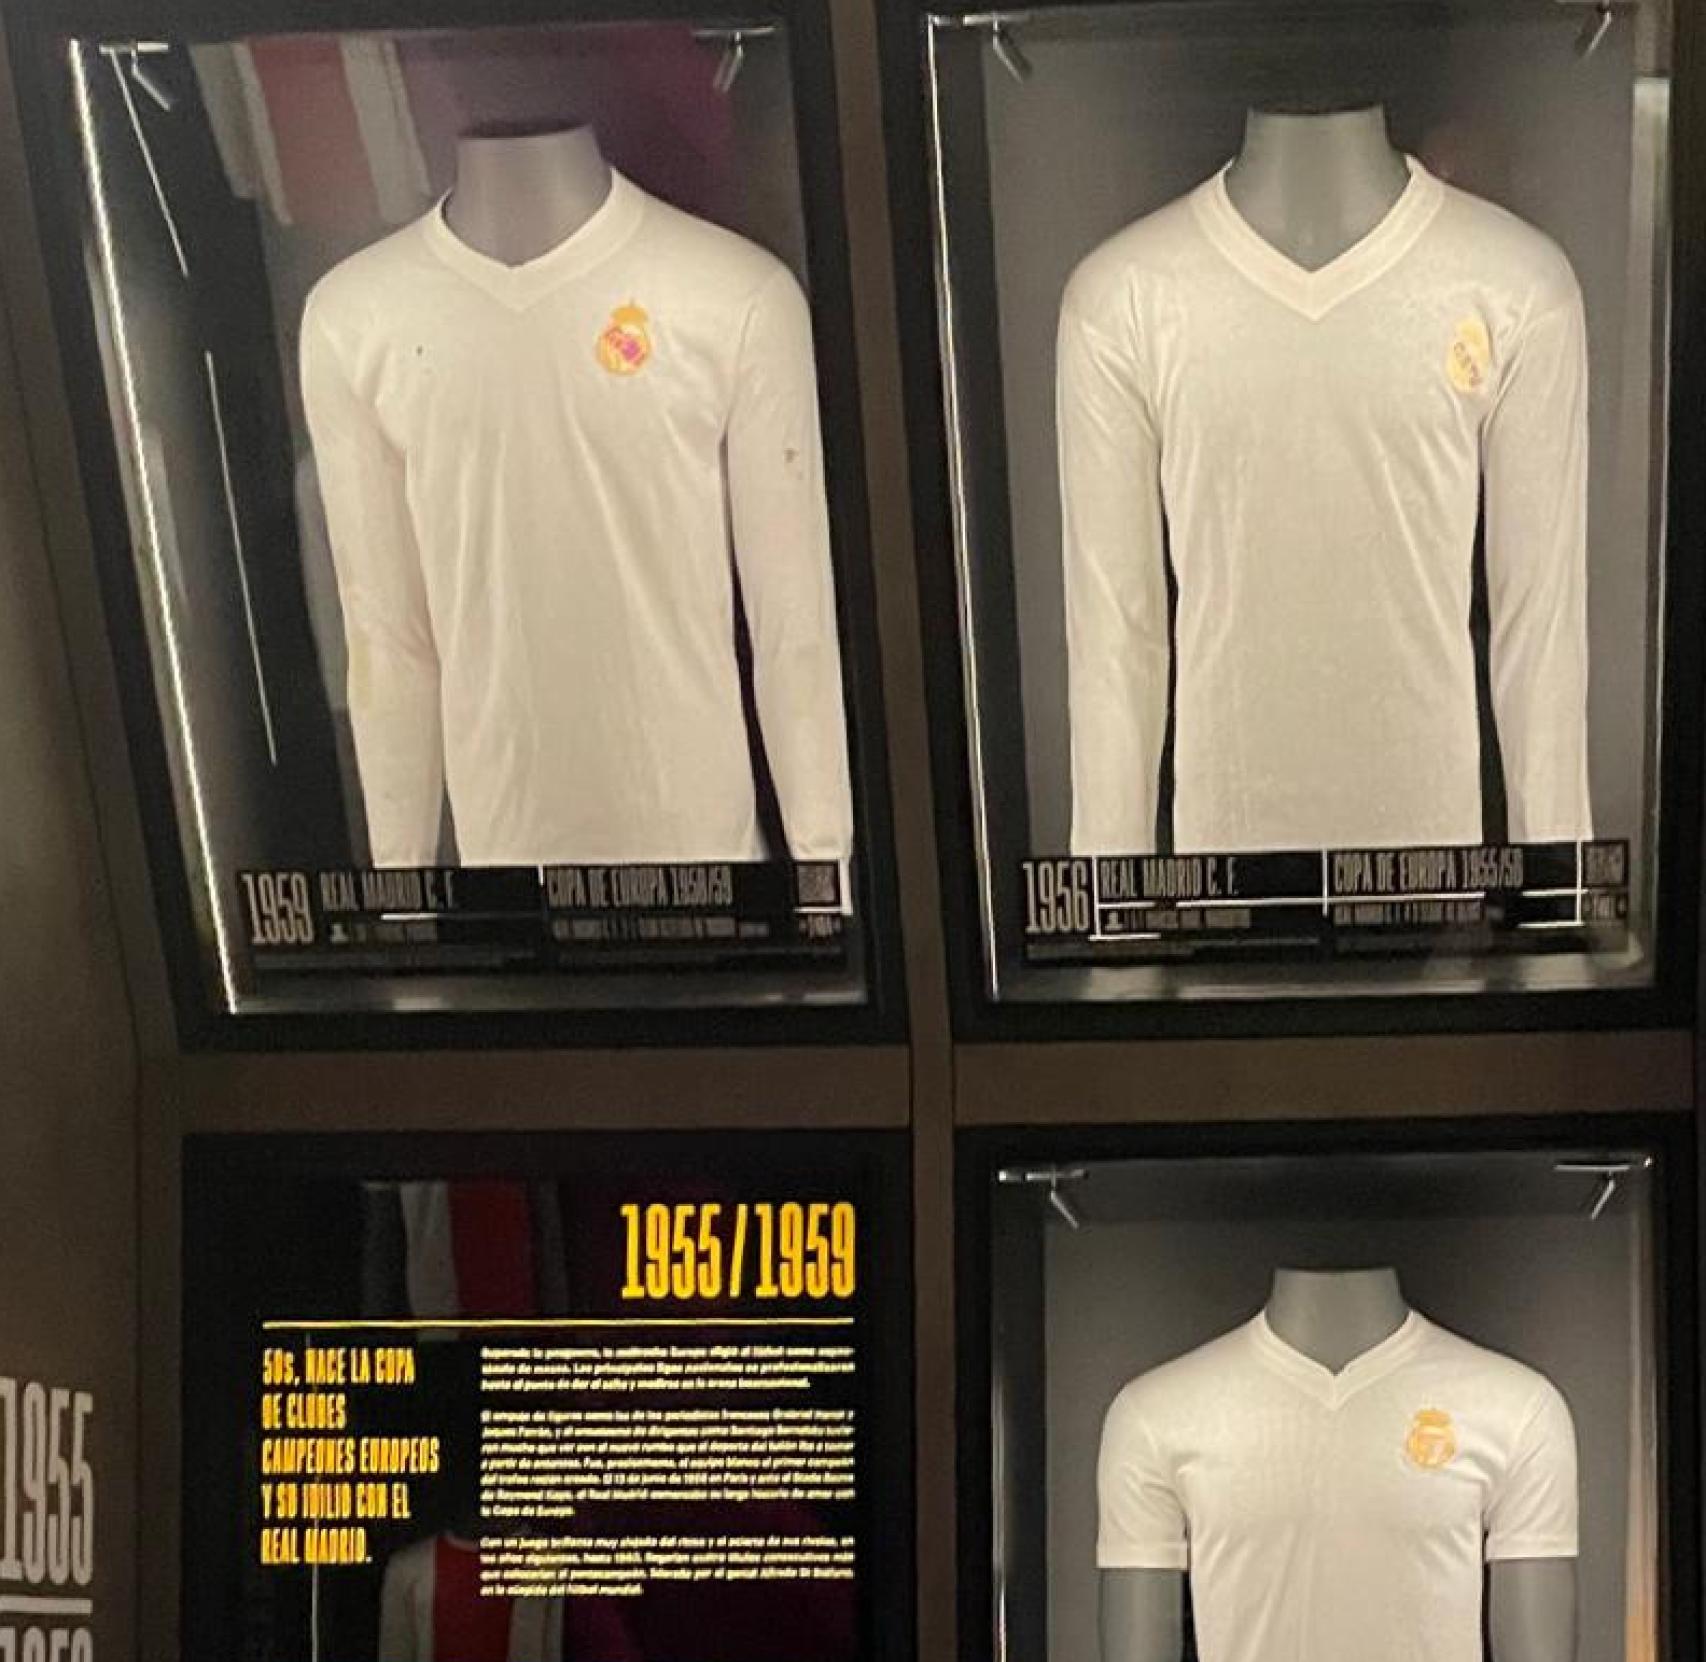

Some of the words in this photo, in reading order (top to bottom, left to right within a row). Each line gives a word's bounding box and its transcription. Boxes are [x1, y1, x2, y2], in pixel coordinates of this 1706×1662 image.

[1100, 858, 1137, 899] REAL
[1143, 857, 1201, 897] MADRID
[1335, 853, 1373, 892] COPA
[1376, 852, 1396, 891] DE
[1399, 850, 1456, 890] EUROPA
[241, 872, 314, 944] 1959
[1022, 861, 1090, 934] 1956
[621, 1202, 855, 1299] 1955/1959
[350, 1348, 370, 1384] LA
[375, 1348, 415, 1384] COPA
[262, 1393, 282, 1429] DE
[286, 1393, 346, 1429] CLUBES
[262, 1437, 355, 1474] CAMPEONES
[359, 1436, 440, 1473] EUROPEOS
[0, 1377, 93, 1585] 1955
[261, 1483, 272, 1519] Y
[391, 1482, 411, 1519] EL
[261, 1528, 299, 1564] REAL
